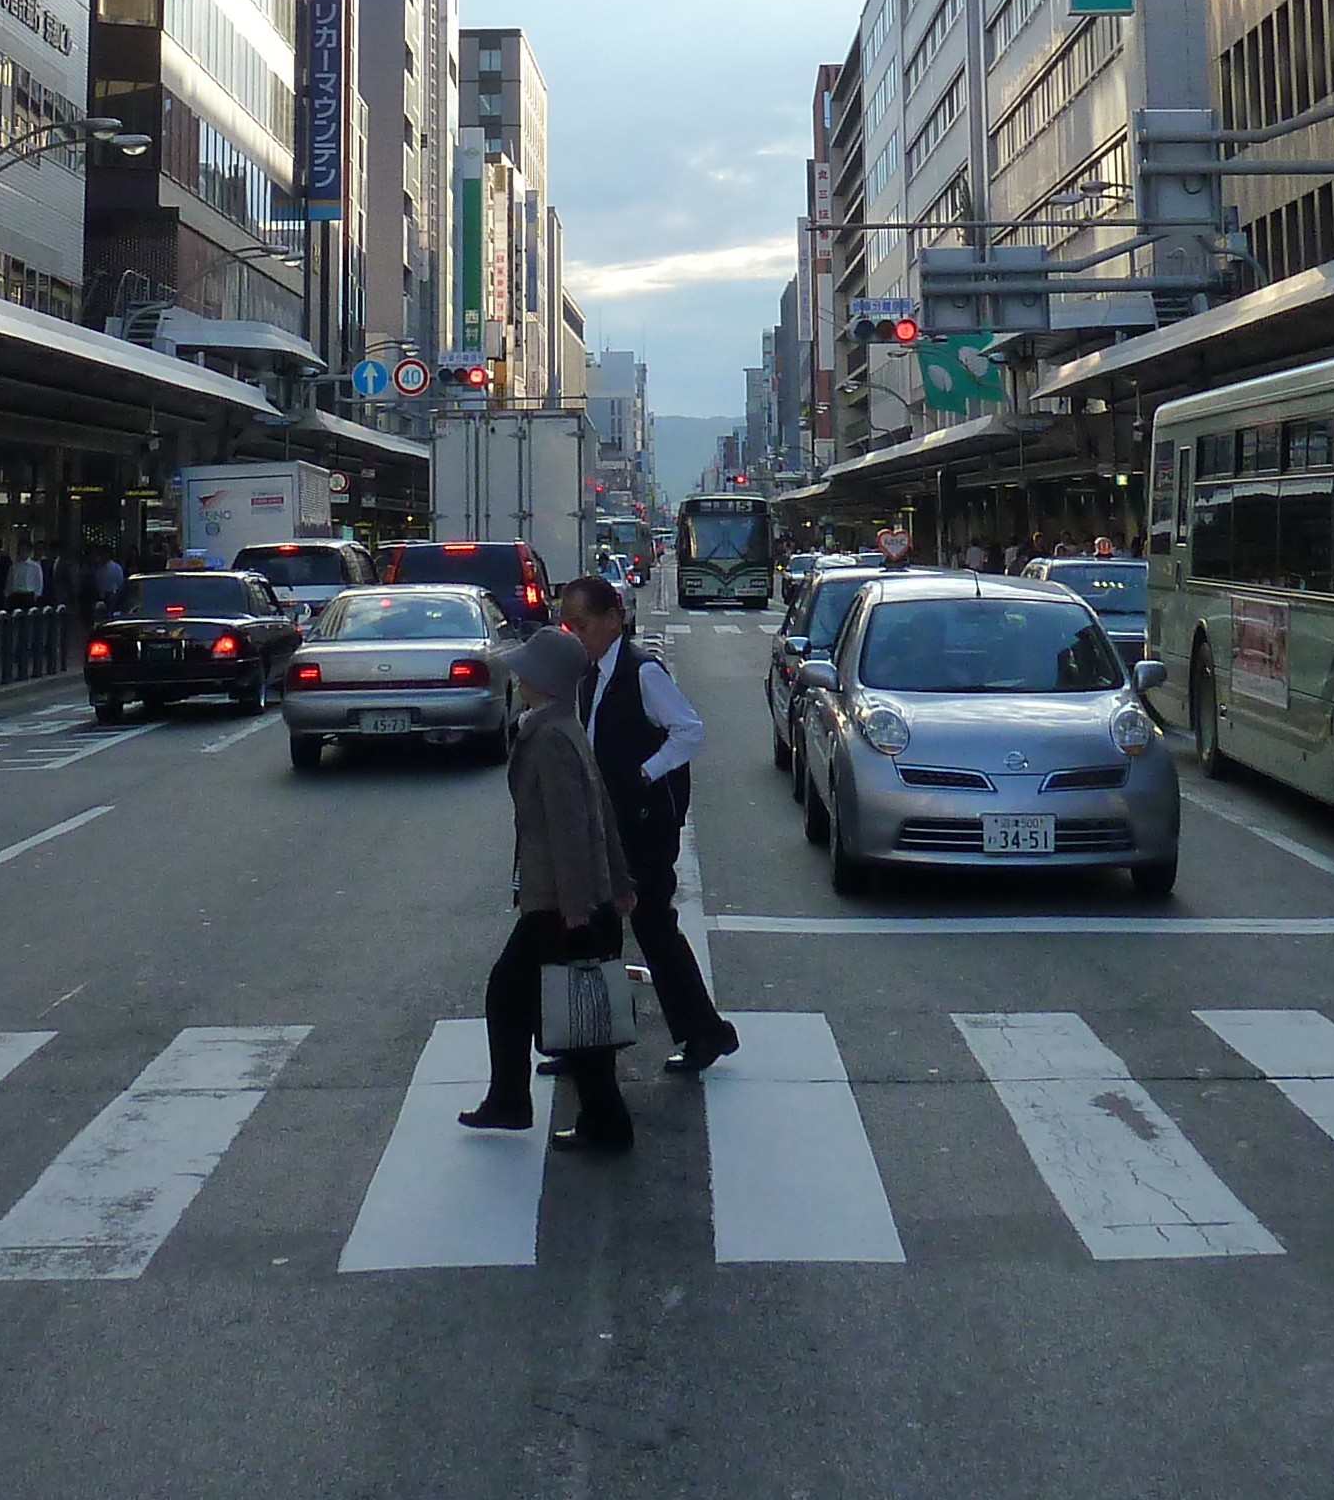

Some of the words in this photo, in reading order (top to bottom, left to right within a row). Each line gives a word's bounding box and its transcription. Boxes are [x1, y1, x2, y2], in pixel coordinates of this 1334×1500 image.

[313, 2, 338, 190] リカーマウンテン
[402, 369, 422, 385] 40
[999, 830, 1048, 850] 34-51
